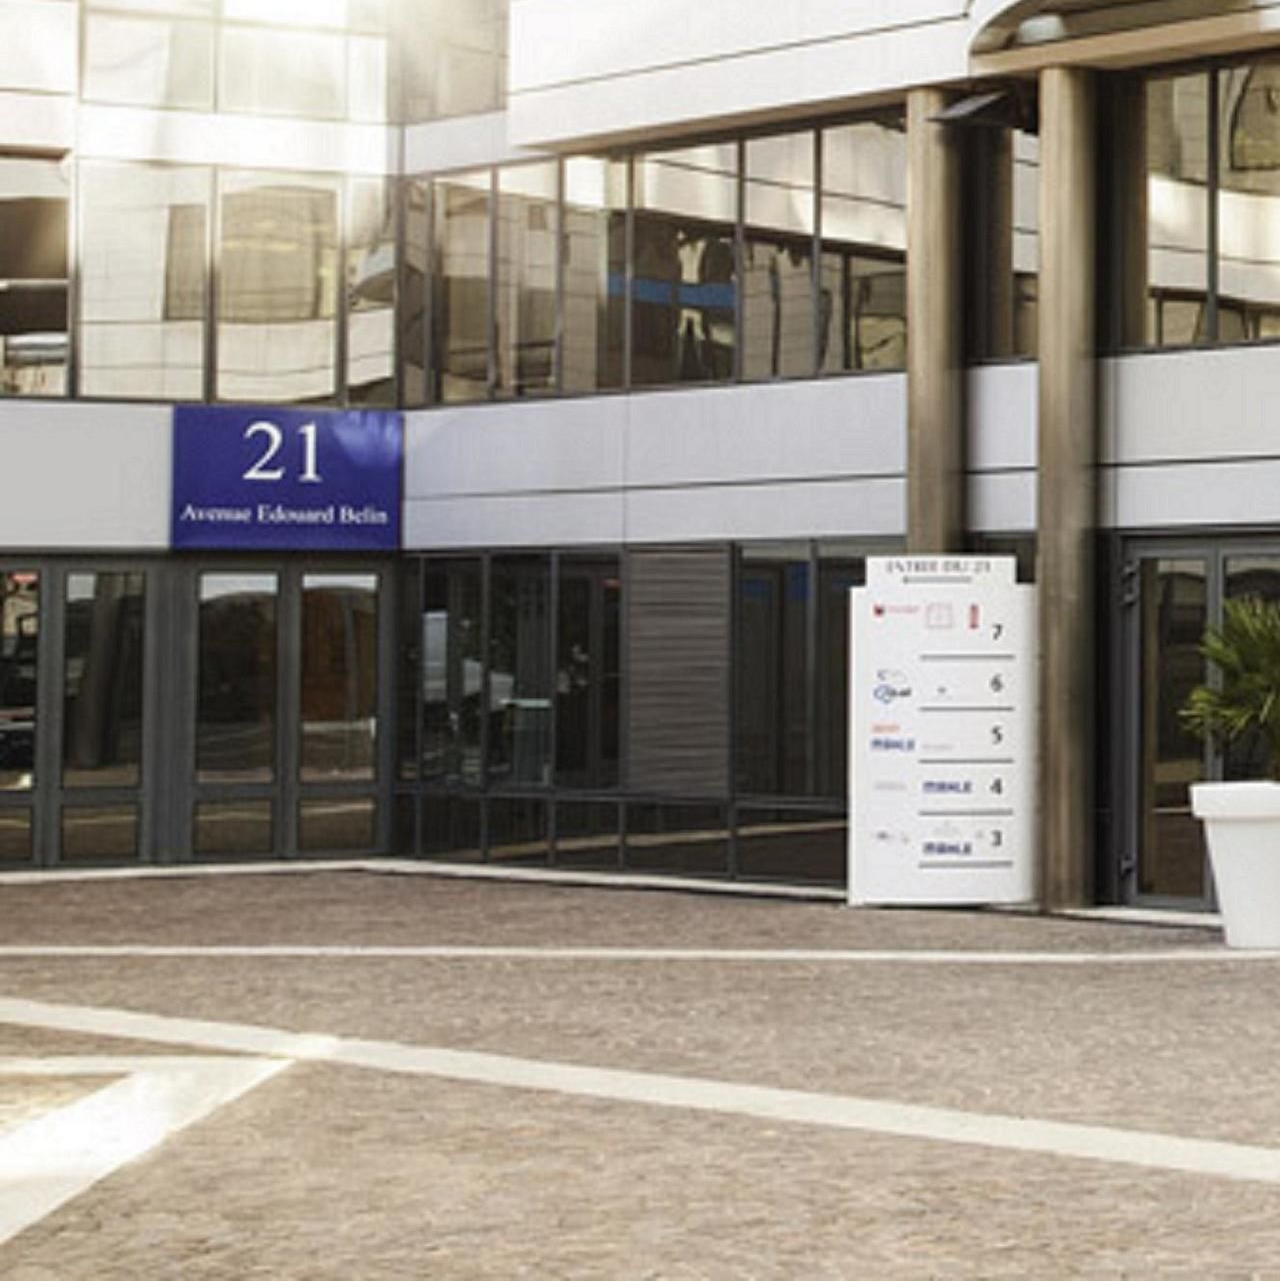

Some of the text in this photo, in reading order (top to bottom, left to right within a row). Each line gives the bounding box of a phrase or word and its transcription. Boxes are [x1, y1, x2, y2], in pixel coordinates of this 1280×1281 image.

[242, 421, 323, 482] 21
[180, 503, 389, 526] Avenue Edouard Belin
[992, 623, 1003, 640] 7
[991, 725, 1003, 745] 5
[989, 777, 1003, 796] 4
